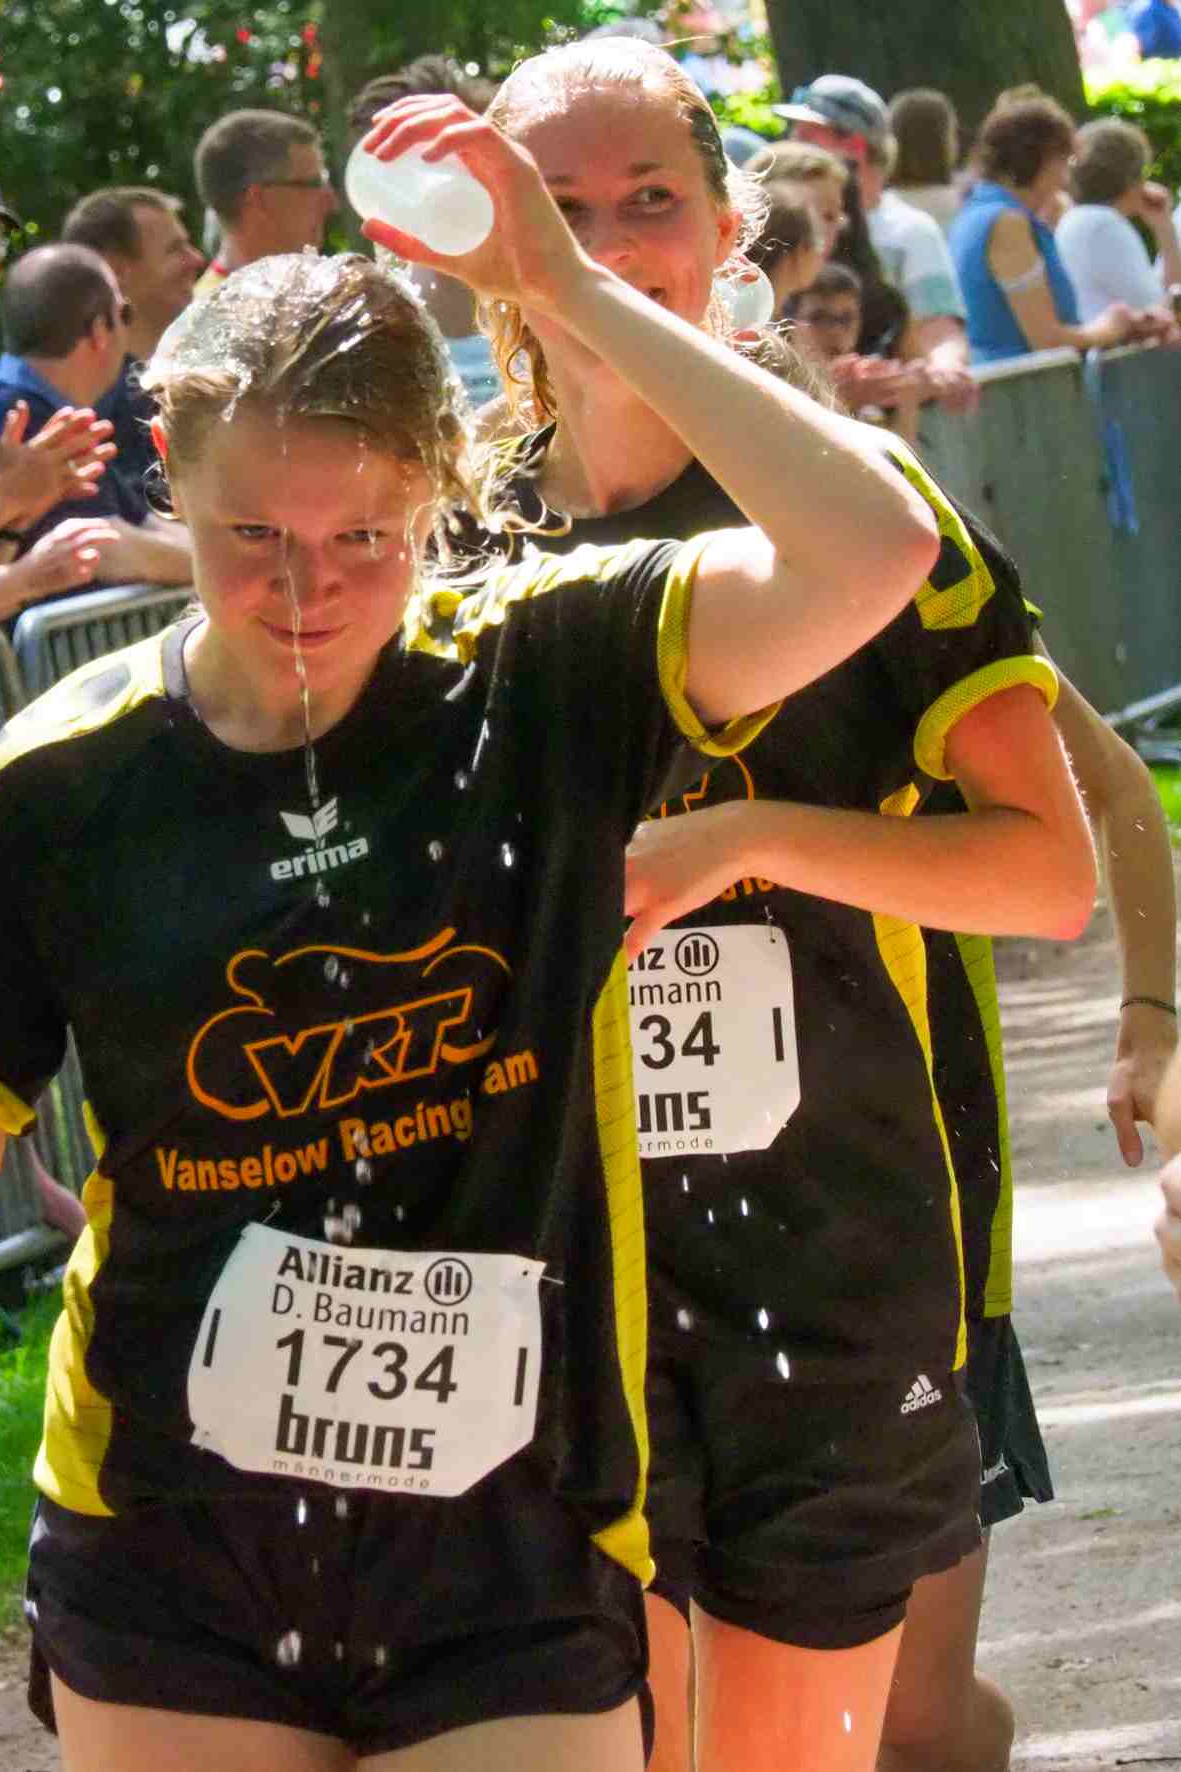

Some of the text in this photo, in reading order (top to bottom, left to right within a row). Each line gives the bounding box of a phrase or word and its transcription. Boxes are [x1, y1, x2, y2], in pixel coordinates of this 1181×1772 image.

[269, 836, 369, 881] erima
[156, 1137, 329, 1192] Vanselow
[339, 1097, 473, 1161] Racing
[277, 1245, 413, 1296] Allianz
[271, 1284, 470, 1336] D. Baumann
[275, 1328, 458, 1404] 1734
[900, 1389, 942, 1414] adidas
[275, 1394, 436, 1470] bruns
